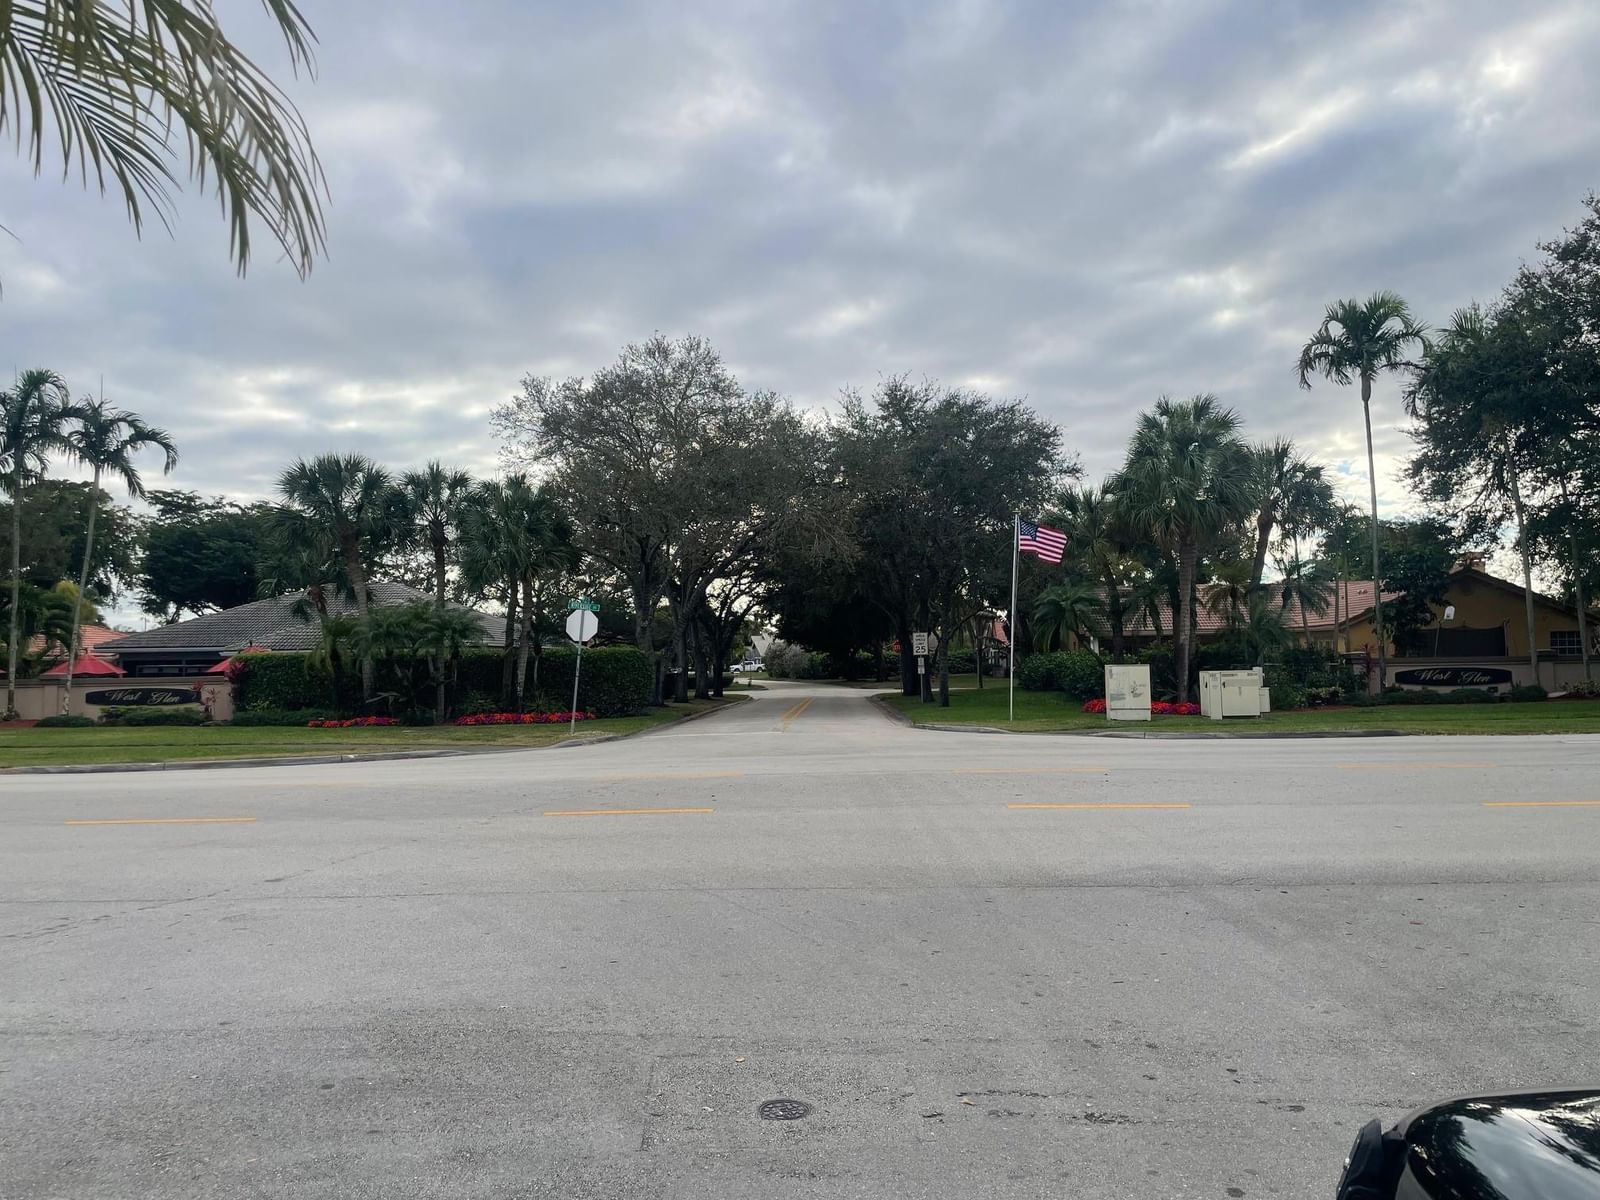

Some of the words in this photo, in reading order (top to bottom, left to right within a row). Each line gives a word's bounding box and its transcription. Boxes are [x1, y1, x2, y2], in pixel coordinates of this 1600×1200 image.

[915, 645, 926, 654] 25
[1414, 670, 1452, 681] West
[1458, 671, 1491, 684] Glen
[105, 690, 141, 702] West
[147, 691, 180, 704] Glen
